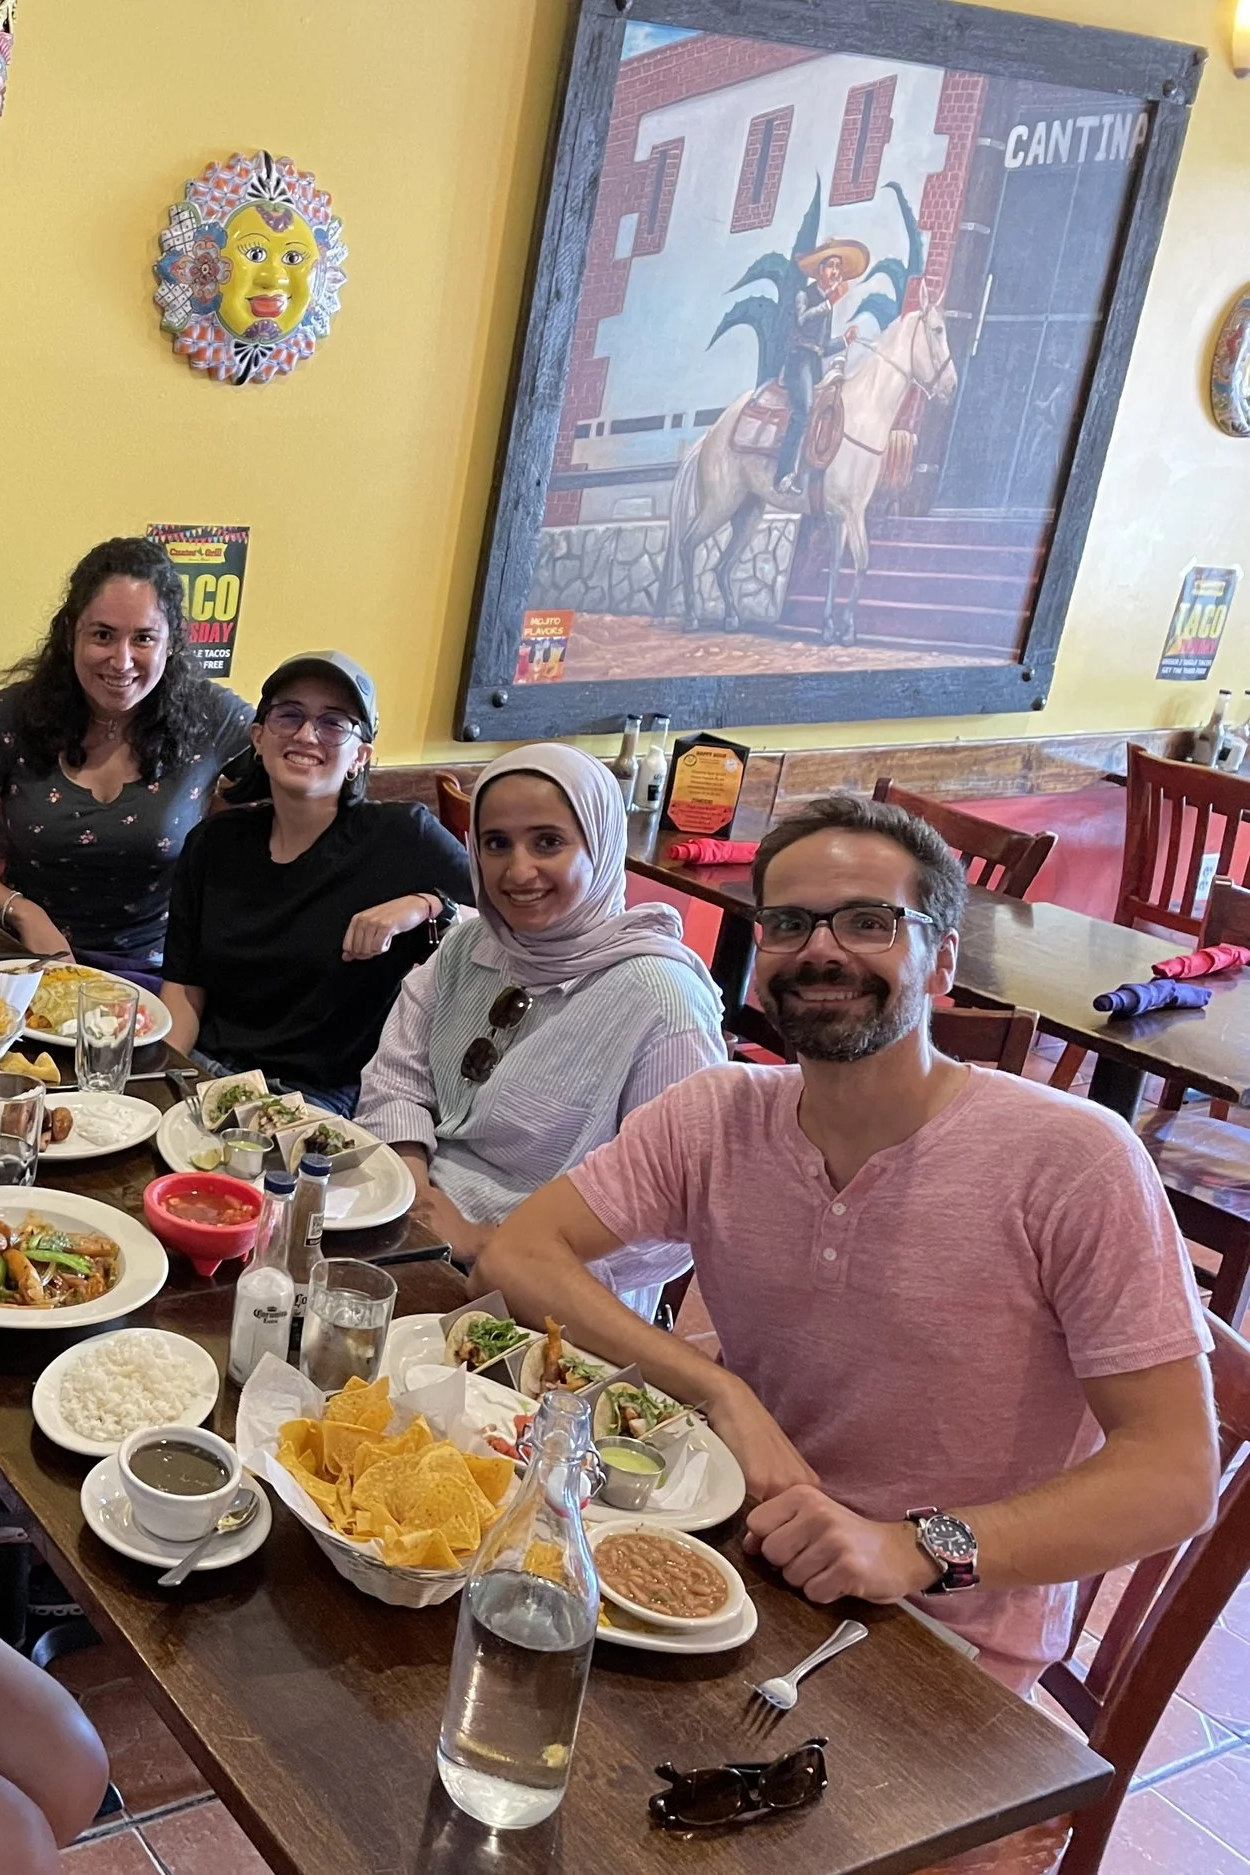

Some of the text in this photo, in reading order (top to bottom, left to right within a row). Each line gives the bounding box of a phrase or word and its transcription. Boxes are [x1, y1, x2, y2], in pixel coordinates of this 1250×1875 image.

[1004, 112, 1148, 169] CANTINA
[179, 573, 240, 622] CO
[530, 617, 561, 626] MOJITO
[188, 622, 234, 643] SDAY
[524, 627, 564, 636] FLAVORS
[204, 649, 231, 658] TACOS
[203, 661, 224, 669] FREE
